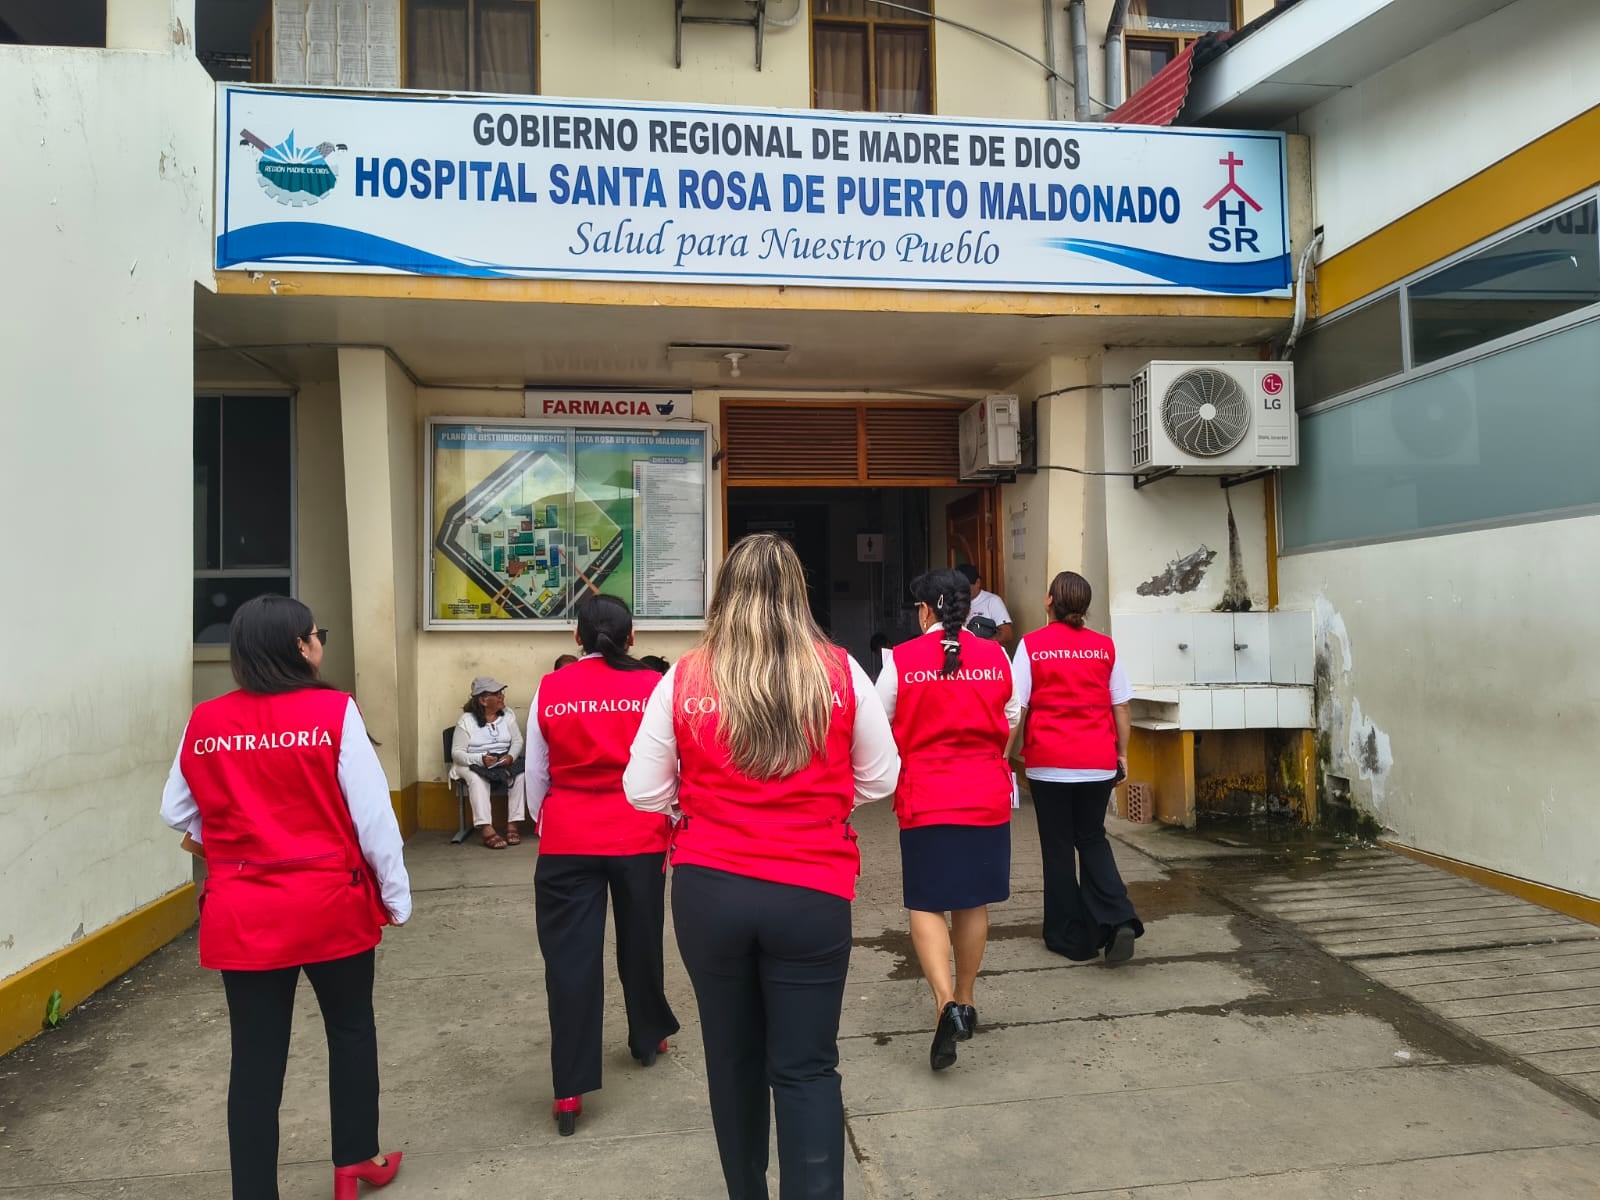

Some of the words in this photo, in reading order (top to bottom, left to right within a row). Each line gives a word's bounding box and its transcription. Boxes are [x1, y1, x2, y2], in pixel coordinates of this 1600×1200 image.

[473, 112, 639, 152] GOBIERNO
[648, 119, 803, 160] REGIONAL
[811, 127, 850, 162] DE
[859, 130, 960, 166] MADRE
[969, 134, 1006, 168] DE
[1015, 136, 1081, 170] DIOS
[355, 156, 538, 204] HOSPITAL
[548, 163, 668, 209] SANTA
[678, 168, 772, 212] ROSA
[782, 173, 826, 214] DE
[836, 175, 968, 220] PUERTO
[979, 181, 1181, 225] MALDONADO
[1219, 200, 1246, 226] H
[568, 218, 675, 256] Salud
[673, 231, 750, 267] para
[758, 227, 887, 262] Nuestro
[896, 229, 1001, 265] Pueblo
[1208, 226, 1261, 253] SR
[542, 399, 652, 416] FARMACIA
[1264, 398, 1282, 410] LG
[441, 432, 466, 441] PLANO
[1031, 647, 1110, 661] CONTRALORÍA
[544, 697, 647, 718] CONTRALORÍ
[193, 726, 333, 755] CONTRALORÍA
